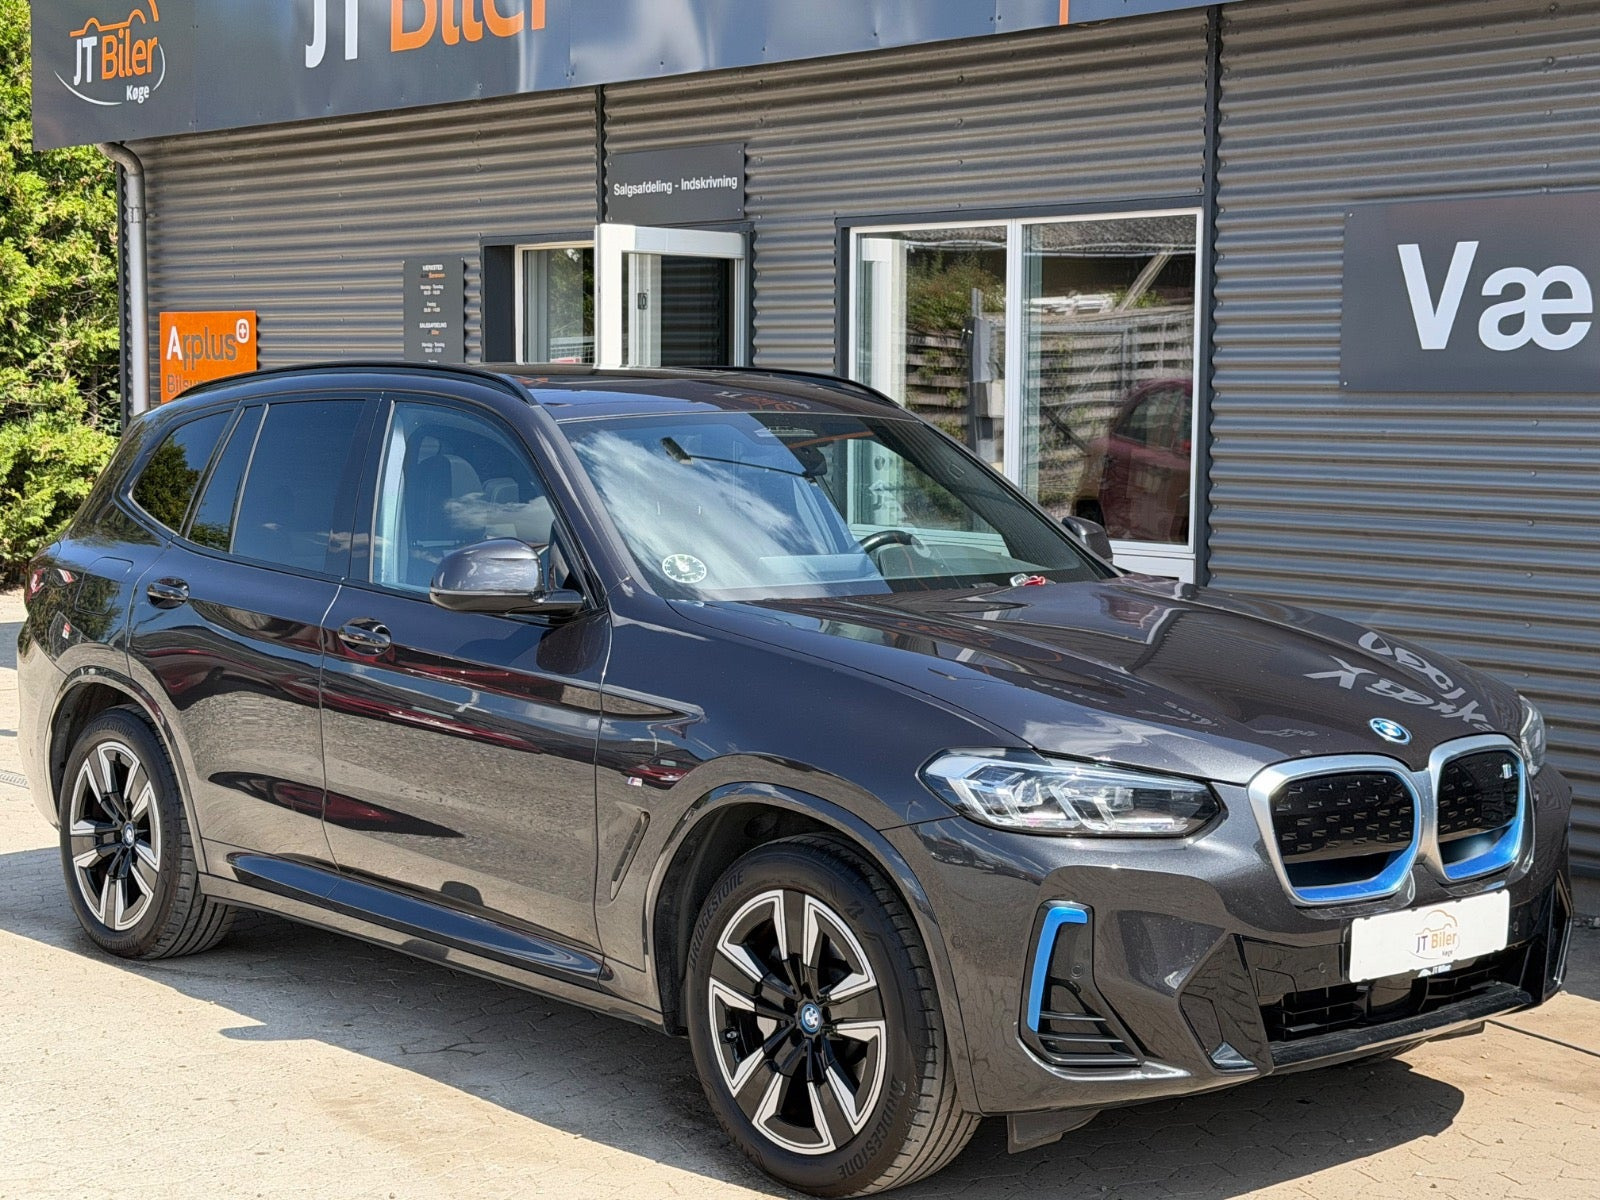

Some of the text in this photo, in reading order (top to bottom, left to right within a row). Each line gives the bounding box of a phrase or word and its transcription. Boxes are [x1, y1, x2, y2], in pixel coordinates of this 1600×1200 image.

[73, 28, 158, 86] JT Biler
[126, 85, 150, 104] Køge
[613, 180, 673, 198] Salgsafdeling
[681, 174, 738, 190] Indskrivning
[1397, 240, 1594, 352] Væ
[166, 325, 238, 371] Applus
[689, 868, 745, 974] BRIDGESTONE
[1416, 932, 1457, 953] JT Biler
[837, 1074, 901, 1179] BRIDGESTONE
